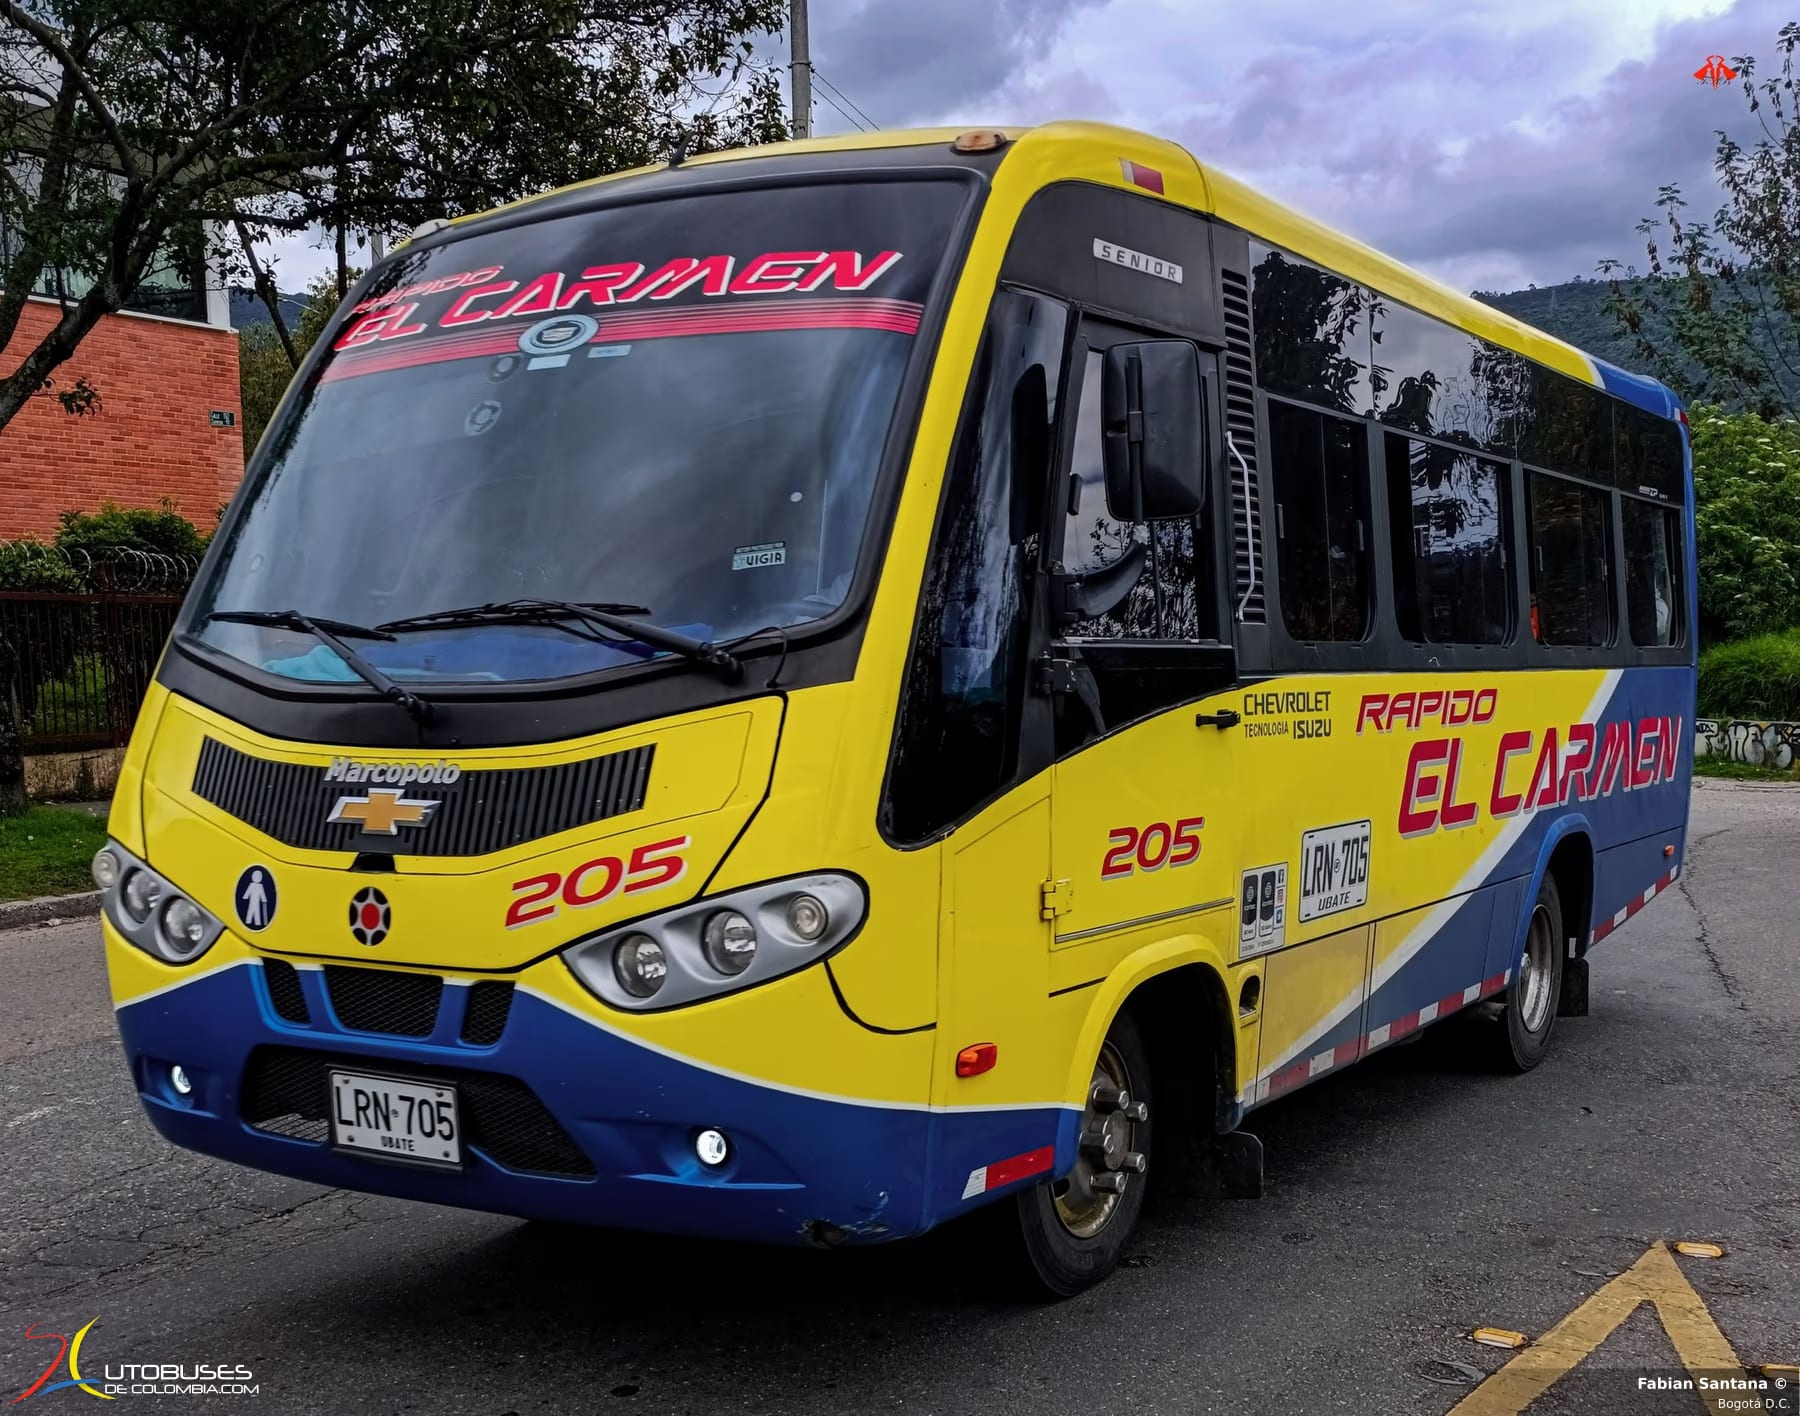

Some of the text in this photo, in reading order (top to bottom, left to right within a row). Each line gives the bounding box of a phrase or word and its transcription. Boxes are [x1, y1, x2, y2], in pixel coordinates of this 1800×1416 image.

[1101, 245, 1177, 280] SENIOR
[333, 250, 903, 351] EL CARMEN
[1244, 691, 1331, 716] CHEVROLET
[1355, 688, 1499, 735] RAPIDO
[1244, 718, 1331, 739] TECNOLOGIA ISUZU
[324, 757, 460, 786] Marcopolo
[1398, 737, 1480, 839] EL
[1489, 715, 1682, 820] CARMEN
[1101, 816, 1205, 881] 205
[504, 835, 691, 929] 205
[1318, 891, 1351, 911] UBATE
